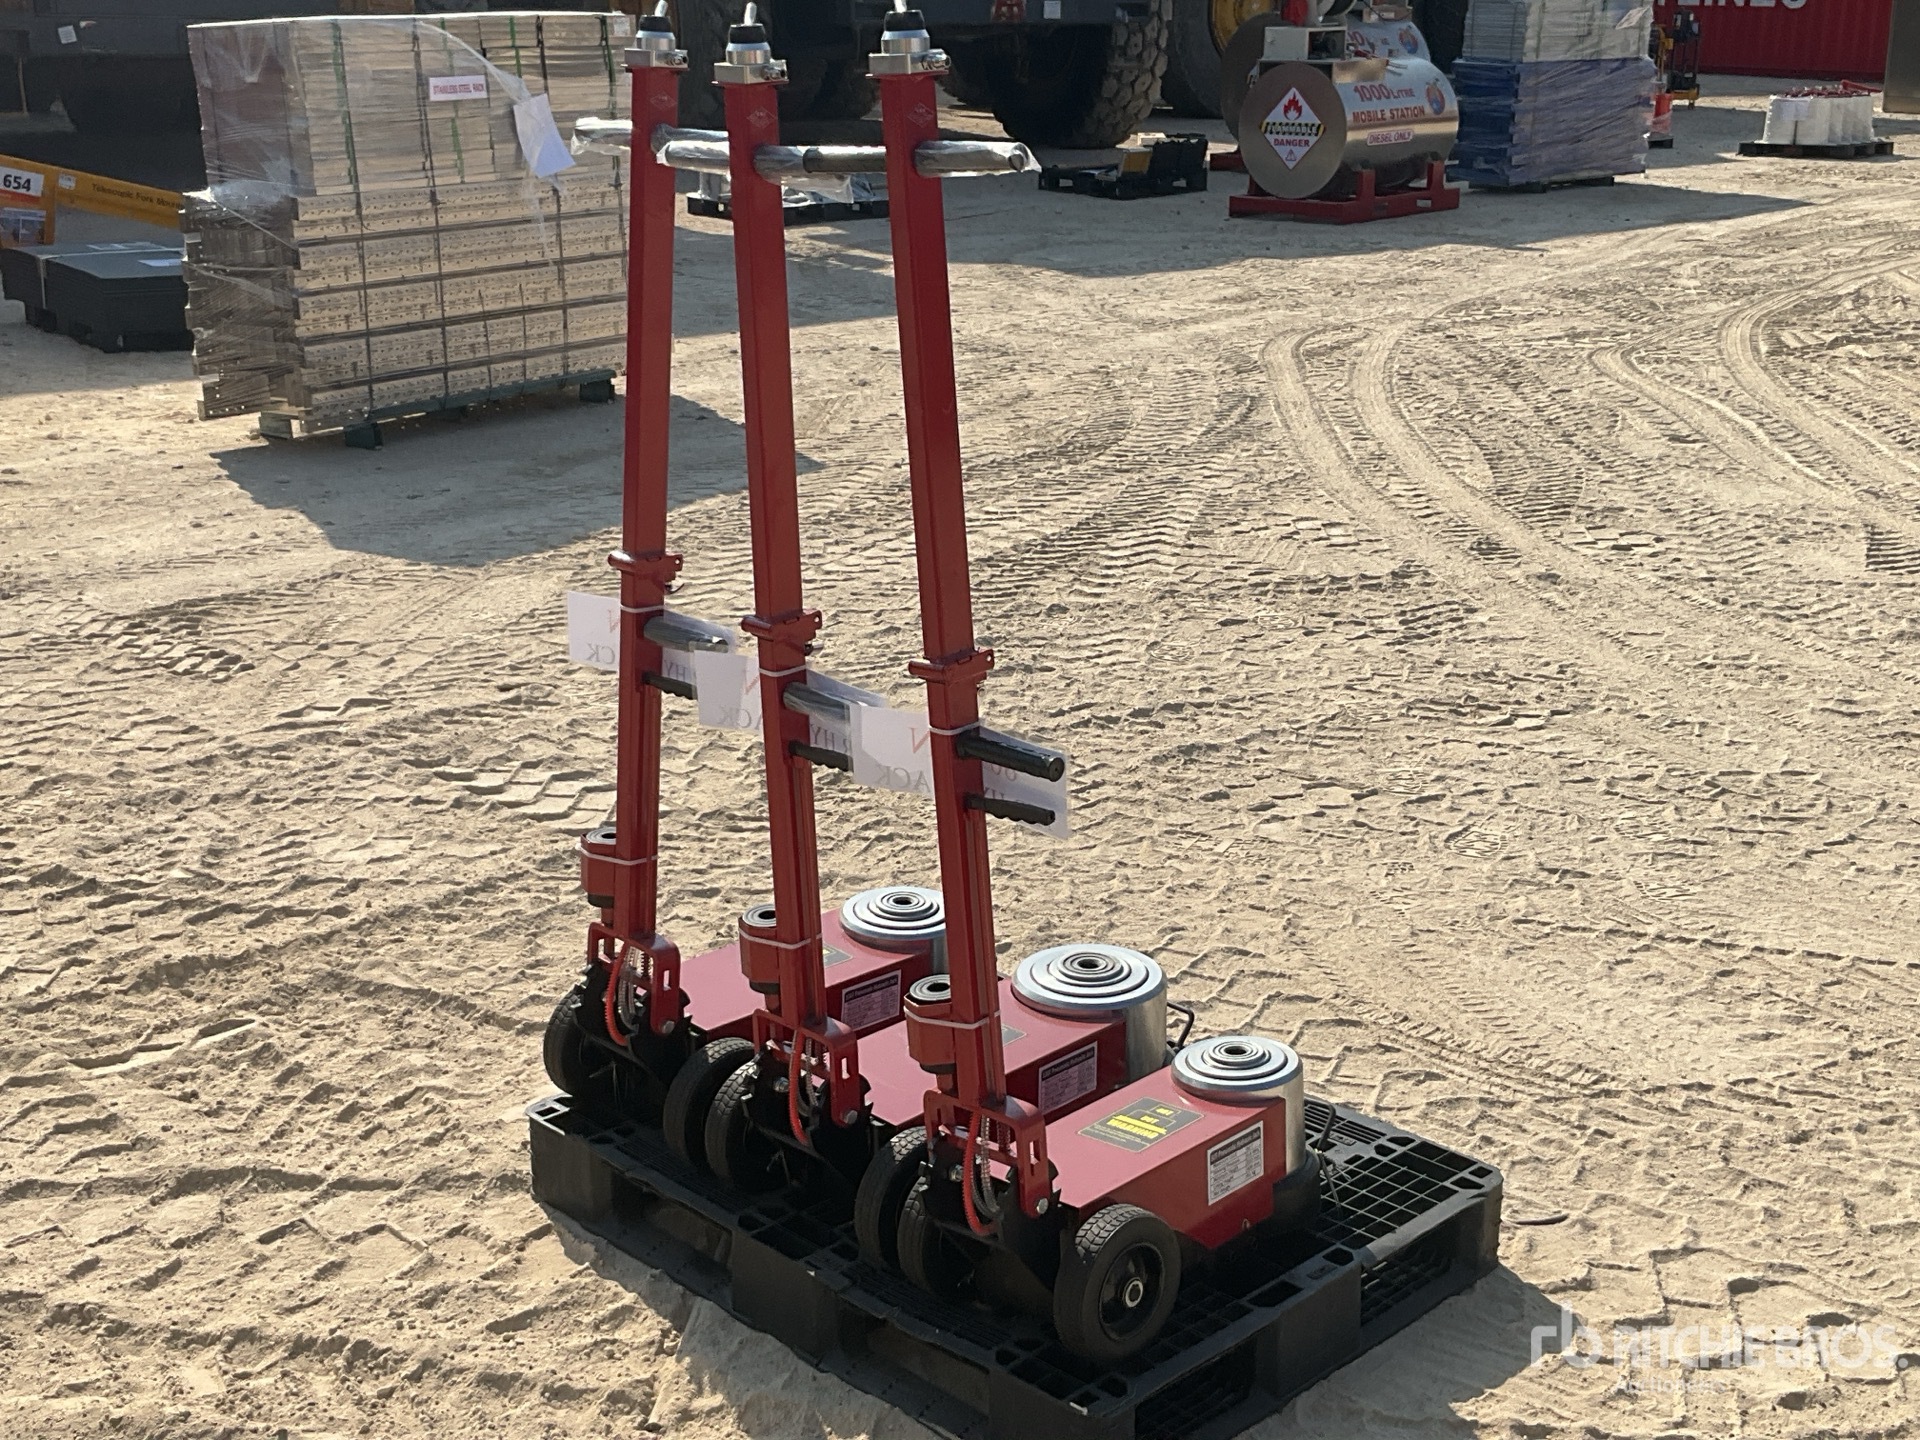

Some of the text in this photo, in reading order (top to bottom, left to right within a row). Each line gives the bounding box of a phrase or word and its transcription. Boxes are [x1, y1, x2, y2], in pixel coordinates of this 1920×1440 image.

[1354, 83, 1391, 102] 1000
[1352, 105, 1425, 123] MOBILE STATION
[1274, 138, 1310, 148] DANGER
[1368, 131, 1411, 144] DIESEL ONLY
[3, 174, 31, 192] 654
[1106, 1118, 1160, 1140] WARNING
